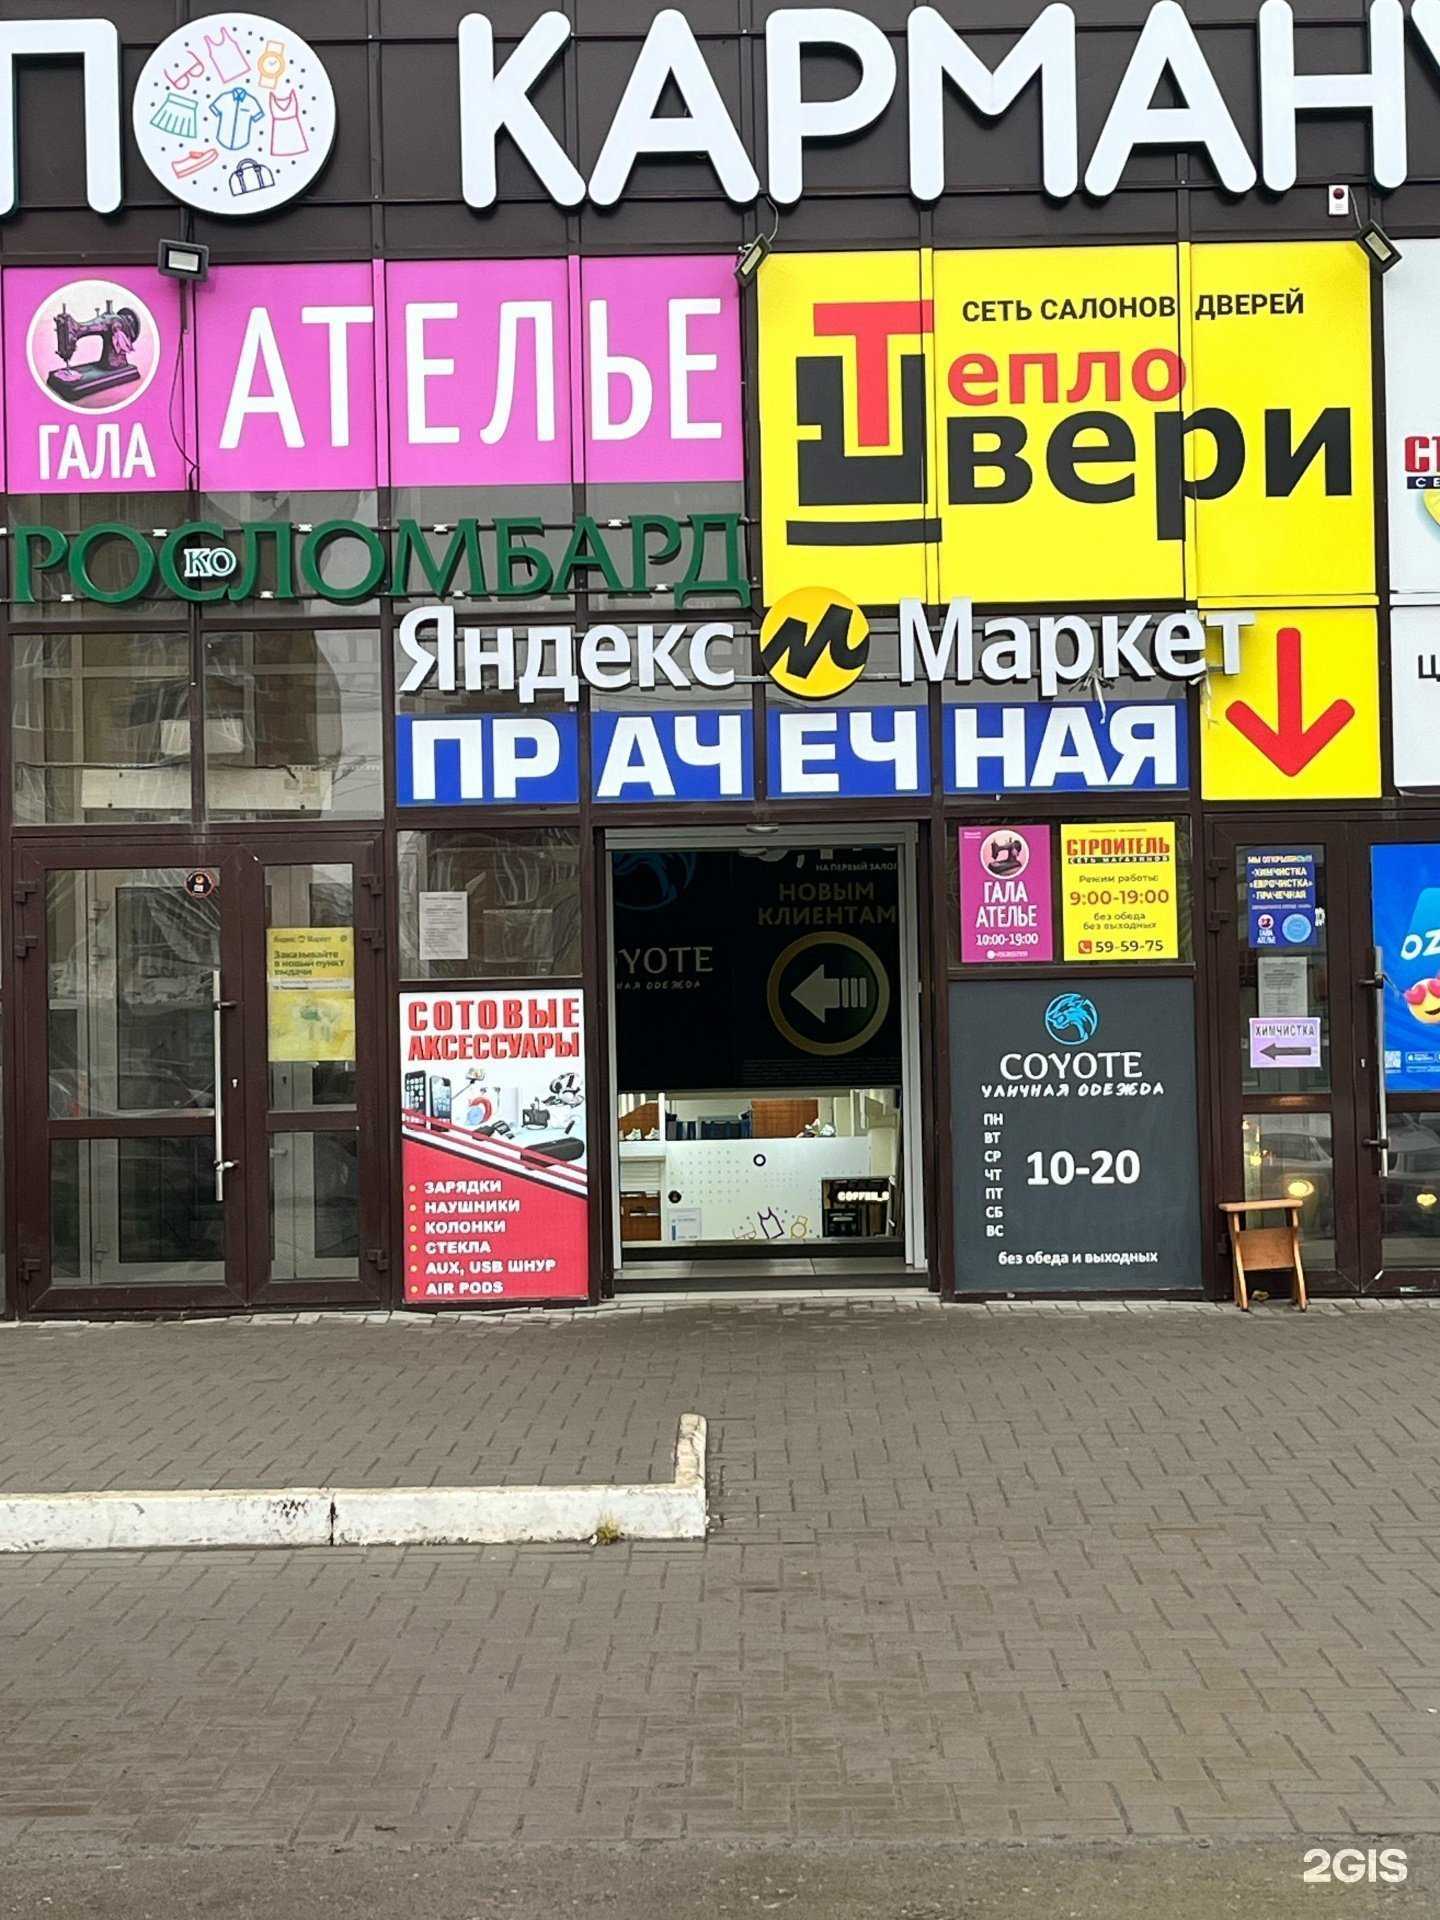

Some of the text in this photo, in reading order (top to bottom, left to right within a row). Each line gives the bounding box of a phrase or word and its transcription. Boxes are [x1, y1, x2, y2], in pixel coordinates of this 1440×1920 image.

[962, 289, 1305, 323] СЕТЬ САЛОНОВ ДВЕРЕЙ
[219, 298, 722, 449] АТЕЛЬЕ
[38, 423, 156, 480] ГАЛА
[13, 513, 752, 609] РОСЛОМБАРД
[183, 547, 237, 578] КО
[399, 604, 736, 703] Яндекс
[898, 595, 1256, 698] Маркет
[411, 705, 1178, 800] ПРАЧЕЧНАЯ
[1067, 837, 1170, 856] СТРОИТЕЛЬ
[1068, 855, 1169, 864] СЕТЬ МАГАЗИНОВ
[1079, 875, 1116, 883] Режим
[779, 881, 875, 901] НОВЫМ
[984, 881, 1028, 903] ГАЛА
[1070, 889, 1169, 906] 9:00-19:00
[758, 905, 897, 926] КЛИЕНТАМ
[976, 905, 1038, 928] АТЕЛЬЕ
[1094, 912, 1146, 921] без обеда
[1083, 921, 1157, 930] без выходных
[976, 933, 1038, 945] 10:00-19:00
[1095, 940, 1164, 953] 59-59-75
[614, 946, 714, 974] YOTE
[408, 998, 580, 1031] СОТОВЫЕ
[1255, 1025, 1315, 1036] ХИМЧИСТКА
[408, 1032, 580, 1061] АКСЕССУАРЫ
[999, 1052, 1143, 1081] COYOTE
[981, 1083, 1069, 1098] УЛИЧНАЯ
[983, 1113, 1003, 1126] ПН
[984, 1132, 1001, 1144] ВТ
[984, 1150, 1001, 1163] СР
[984, 1169, 1002, 1181] ЧТ
[1026, 1149, 1141, 1186] 10-20
[424, 1180, 502, 1195] ЗАРЯДКИ
[985, 1187, 1003, 1200] ПТ
[424, 1200, 520, 1214] НАУШНИКИ
[985, 1206, 1003, 1218] СБ
[424, 1220, 506, 1234] КОЛОНКИ
[986, 1225, 1004, 1237] ВС
[425, 1241, 492, 1255] СТЕКЛА
[998, 1251, 1158, 1266] без обеда и выходных
[425, 1259, 556, 1276] AUX, USB ШНУР
[425, 1281, 504, 1295] AIR PODS
